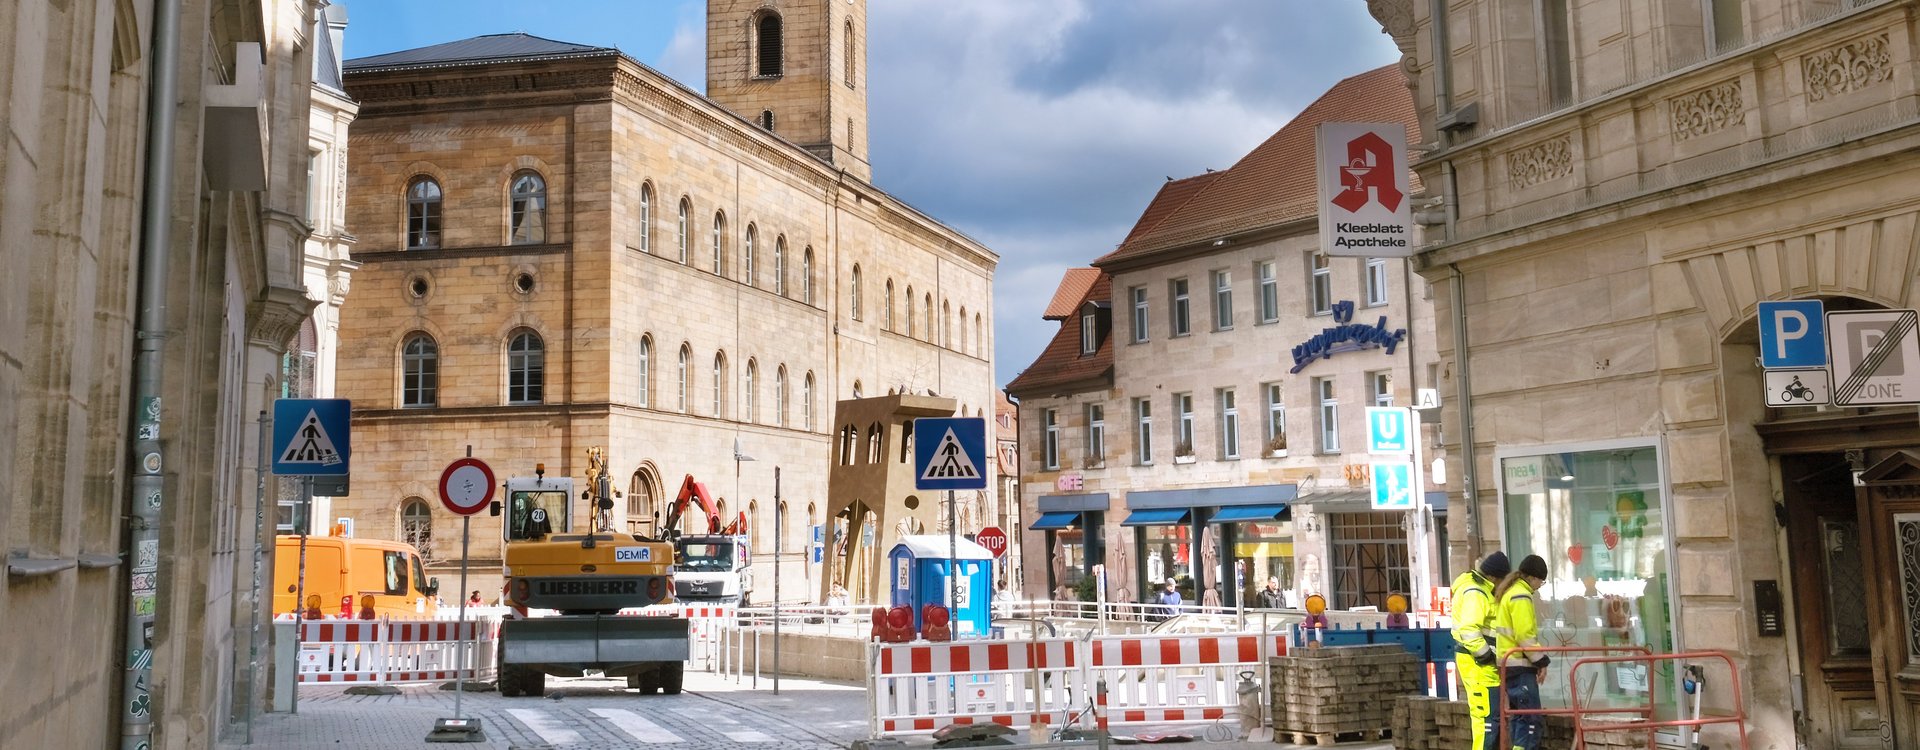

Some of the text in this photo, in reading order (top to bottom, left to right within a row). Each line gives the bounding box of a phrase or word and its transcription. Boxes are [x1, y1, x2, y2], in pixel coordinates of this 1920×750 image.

[1331, 132, 1403, 213] A
[1336, 222, 1404, 233] Kleeblatt
[1335, 236, 1406, 249] Apotheke
[1774, 309, 1809, 359] P
[1859, 329, 1886, 370] P
[1858, 383, 1902, 399] ZONE
[1423, 392, 1434, 406] A
[1378, 413, 1398, 439] U
[534, 508, 544, 520] 20
[979, 535, 1005, 549] STOP
[616, 549, 649, 560] DEMIR
[540, 581, 638, 595] LIEBHERR
